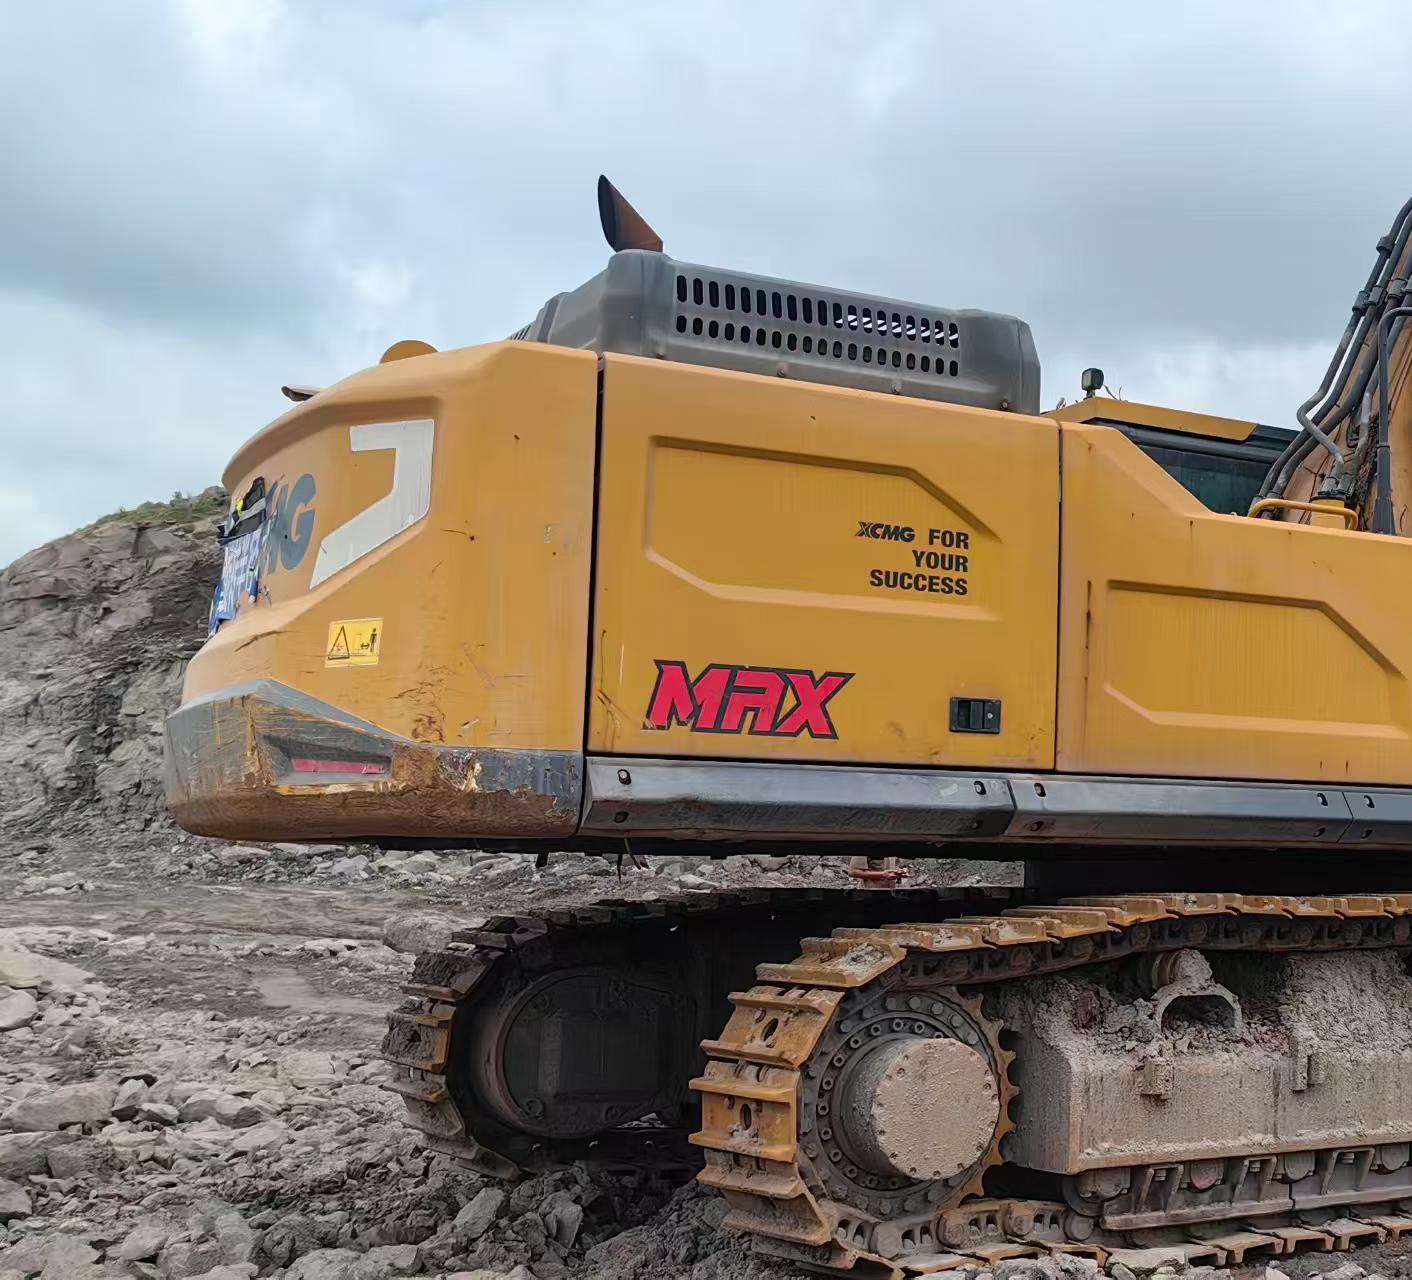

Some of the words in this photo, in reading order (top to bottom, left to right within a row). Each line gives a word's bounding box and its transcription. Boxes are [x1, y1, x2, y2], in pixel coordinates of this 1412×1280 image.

[855, 521, 916, 543] XCMG
[928, 528, 969, 550] FOR
[911, 549, 969, 572] YOUR
[869, 569, 968, 596] SUCCESS
[641, 659, 856, 740] MAX
